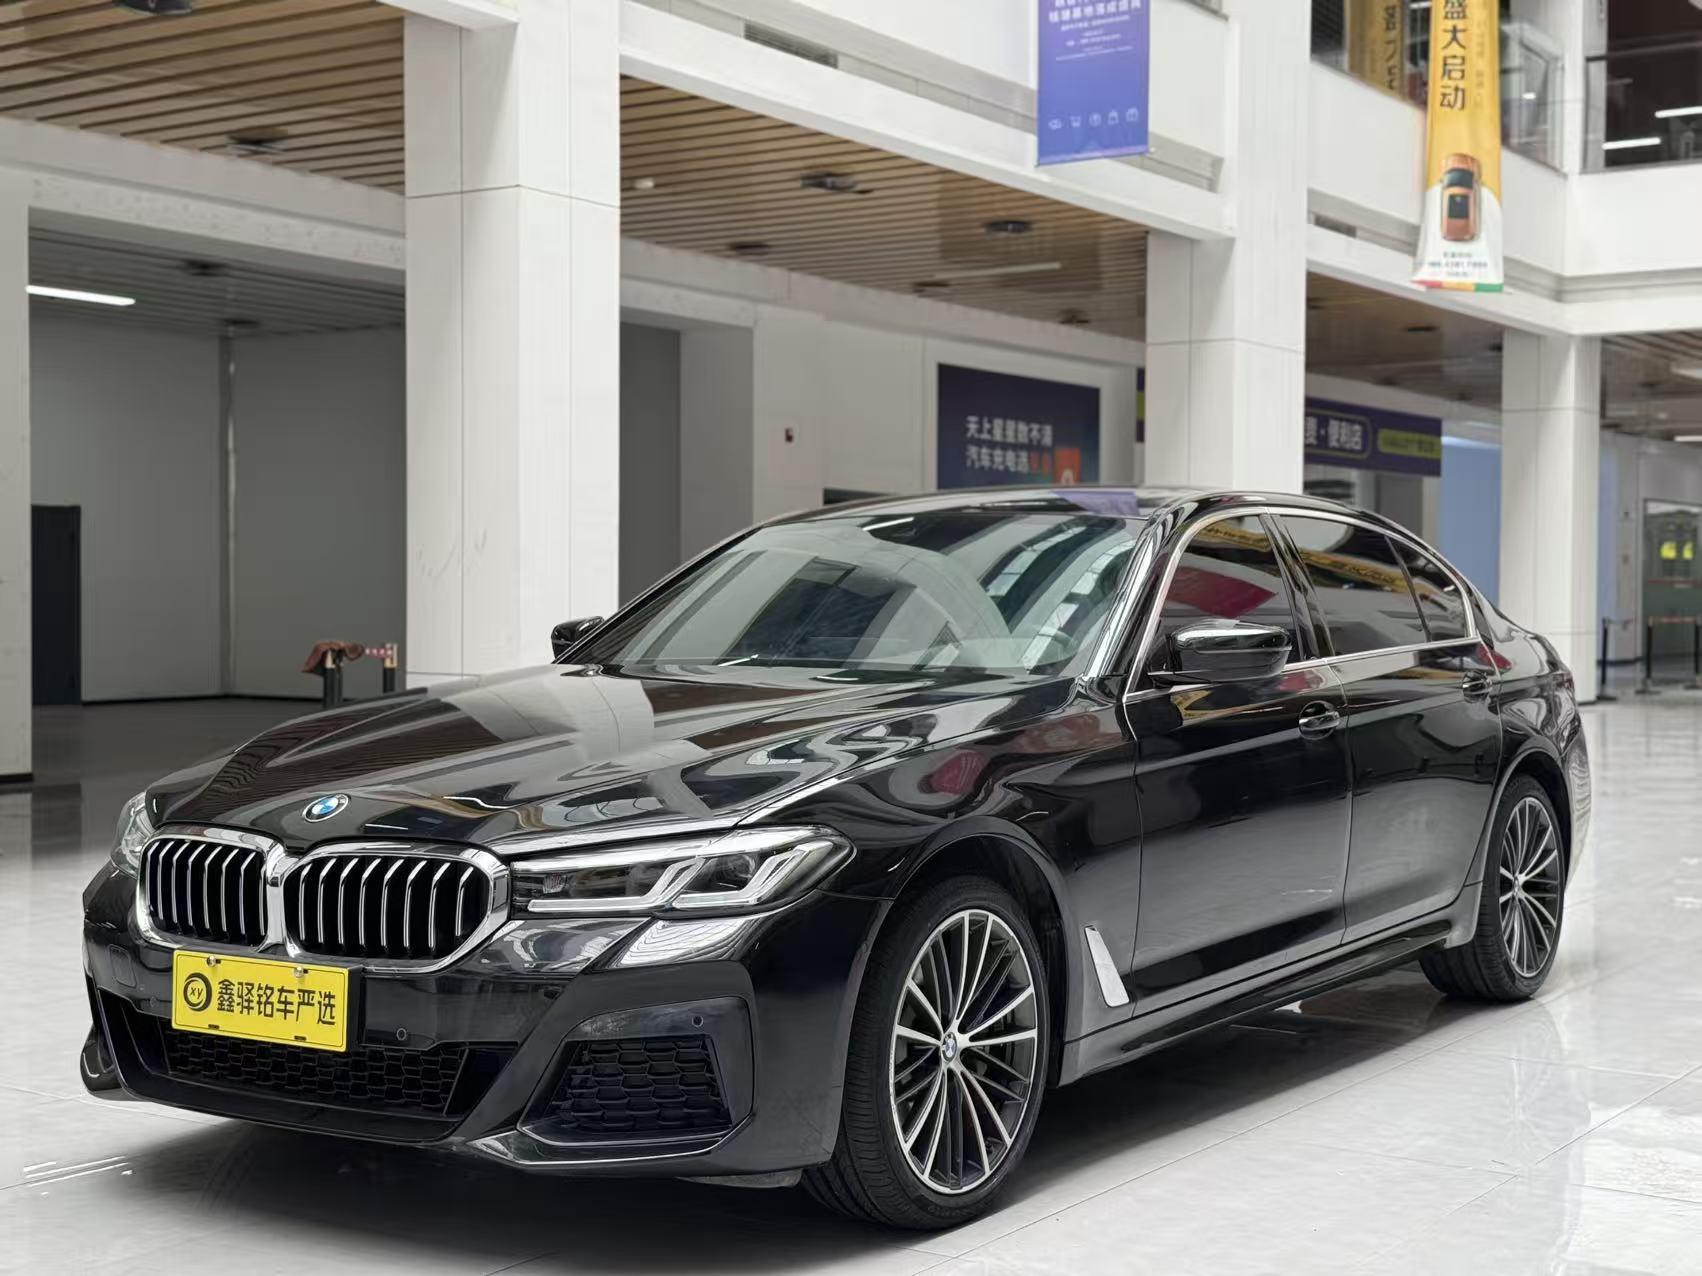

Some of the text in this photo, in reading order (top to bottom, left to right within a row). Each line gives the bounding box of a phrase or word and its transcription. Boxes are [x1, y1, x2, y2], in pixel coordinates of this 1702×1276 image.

[216, 978, 337, 1026] 鑫驿铭车严选
